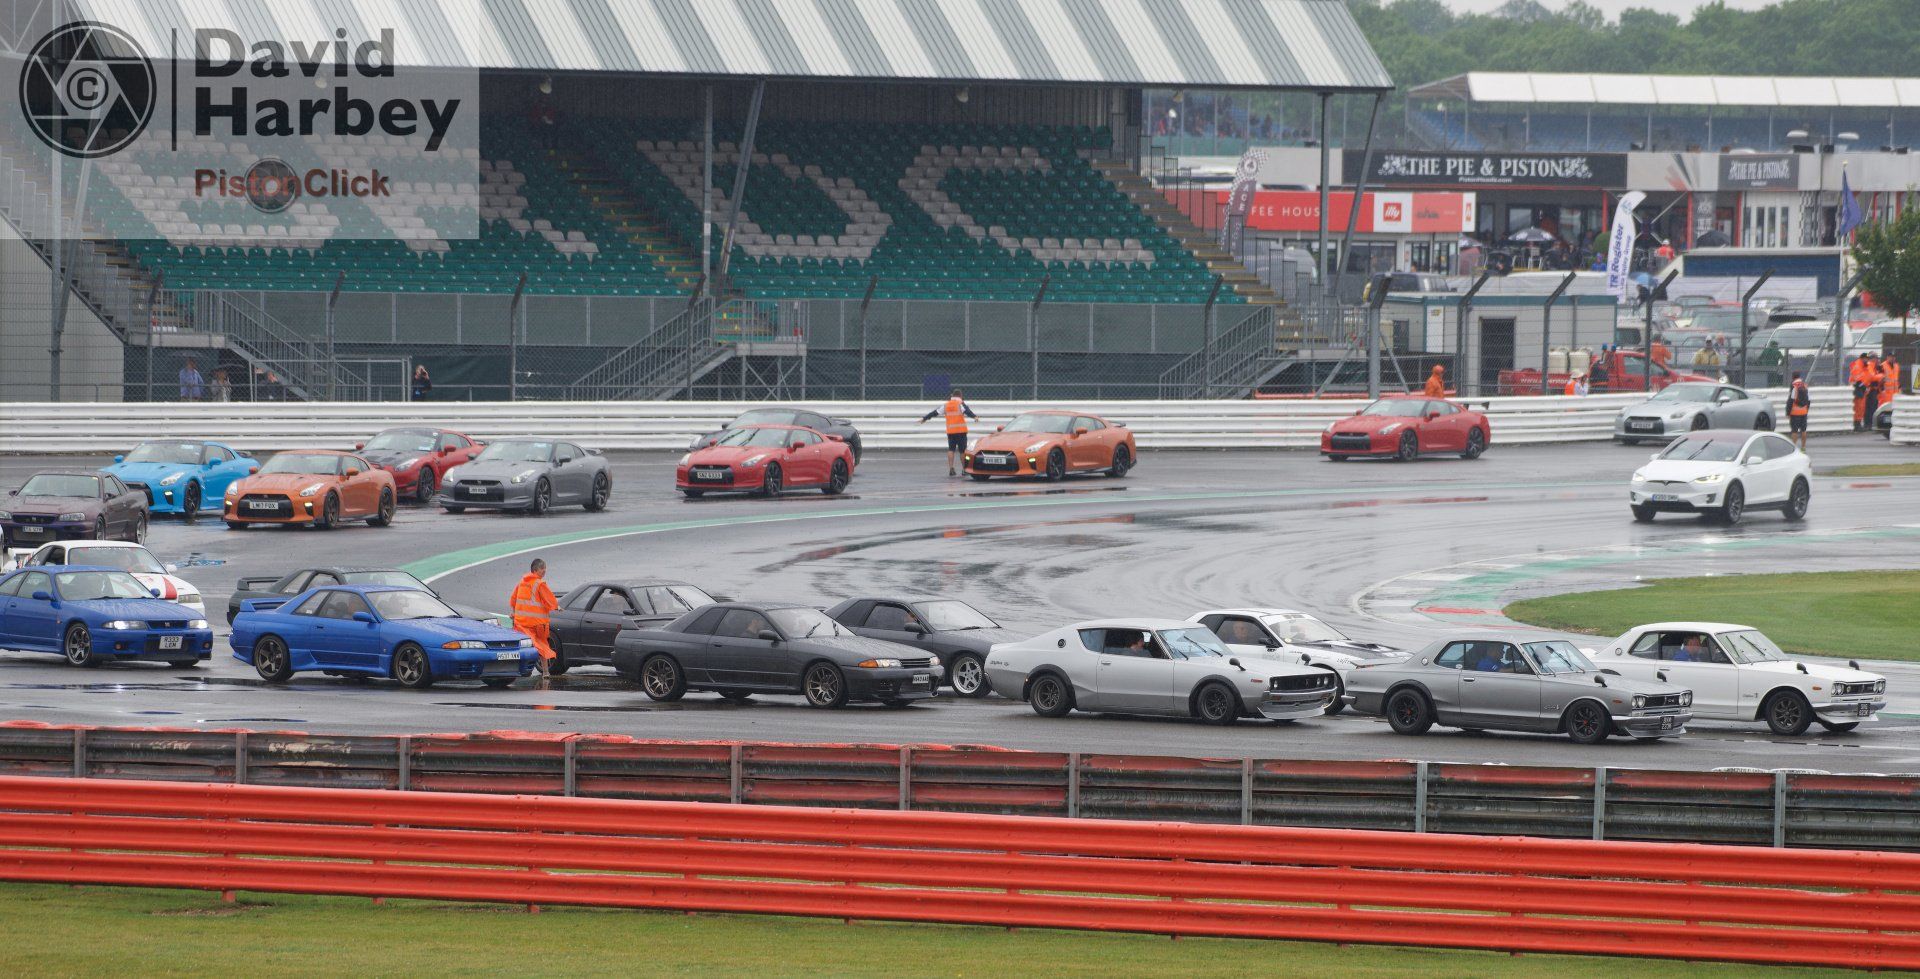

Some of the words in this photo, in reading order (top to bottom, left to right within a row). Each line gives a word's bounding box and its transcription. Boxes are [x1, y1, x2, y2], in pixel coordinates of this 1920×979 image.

[1407, 157, 1441, 176] THE
[1446, 157, 1475, 176] PIE
[1479, 157, 1494, 176] &
[1500, 157, 1565, 178] PISTON
[1282, 206, 1321, 217] HOUS
[1385, 205, 1401, 219] illy
[1611, 223, 1624, 273] Register
[1609, 274, 1619, 289] TR
